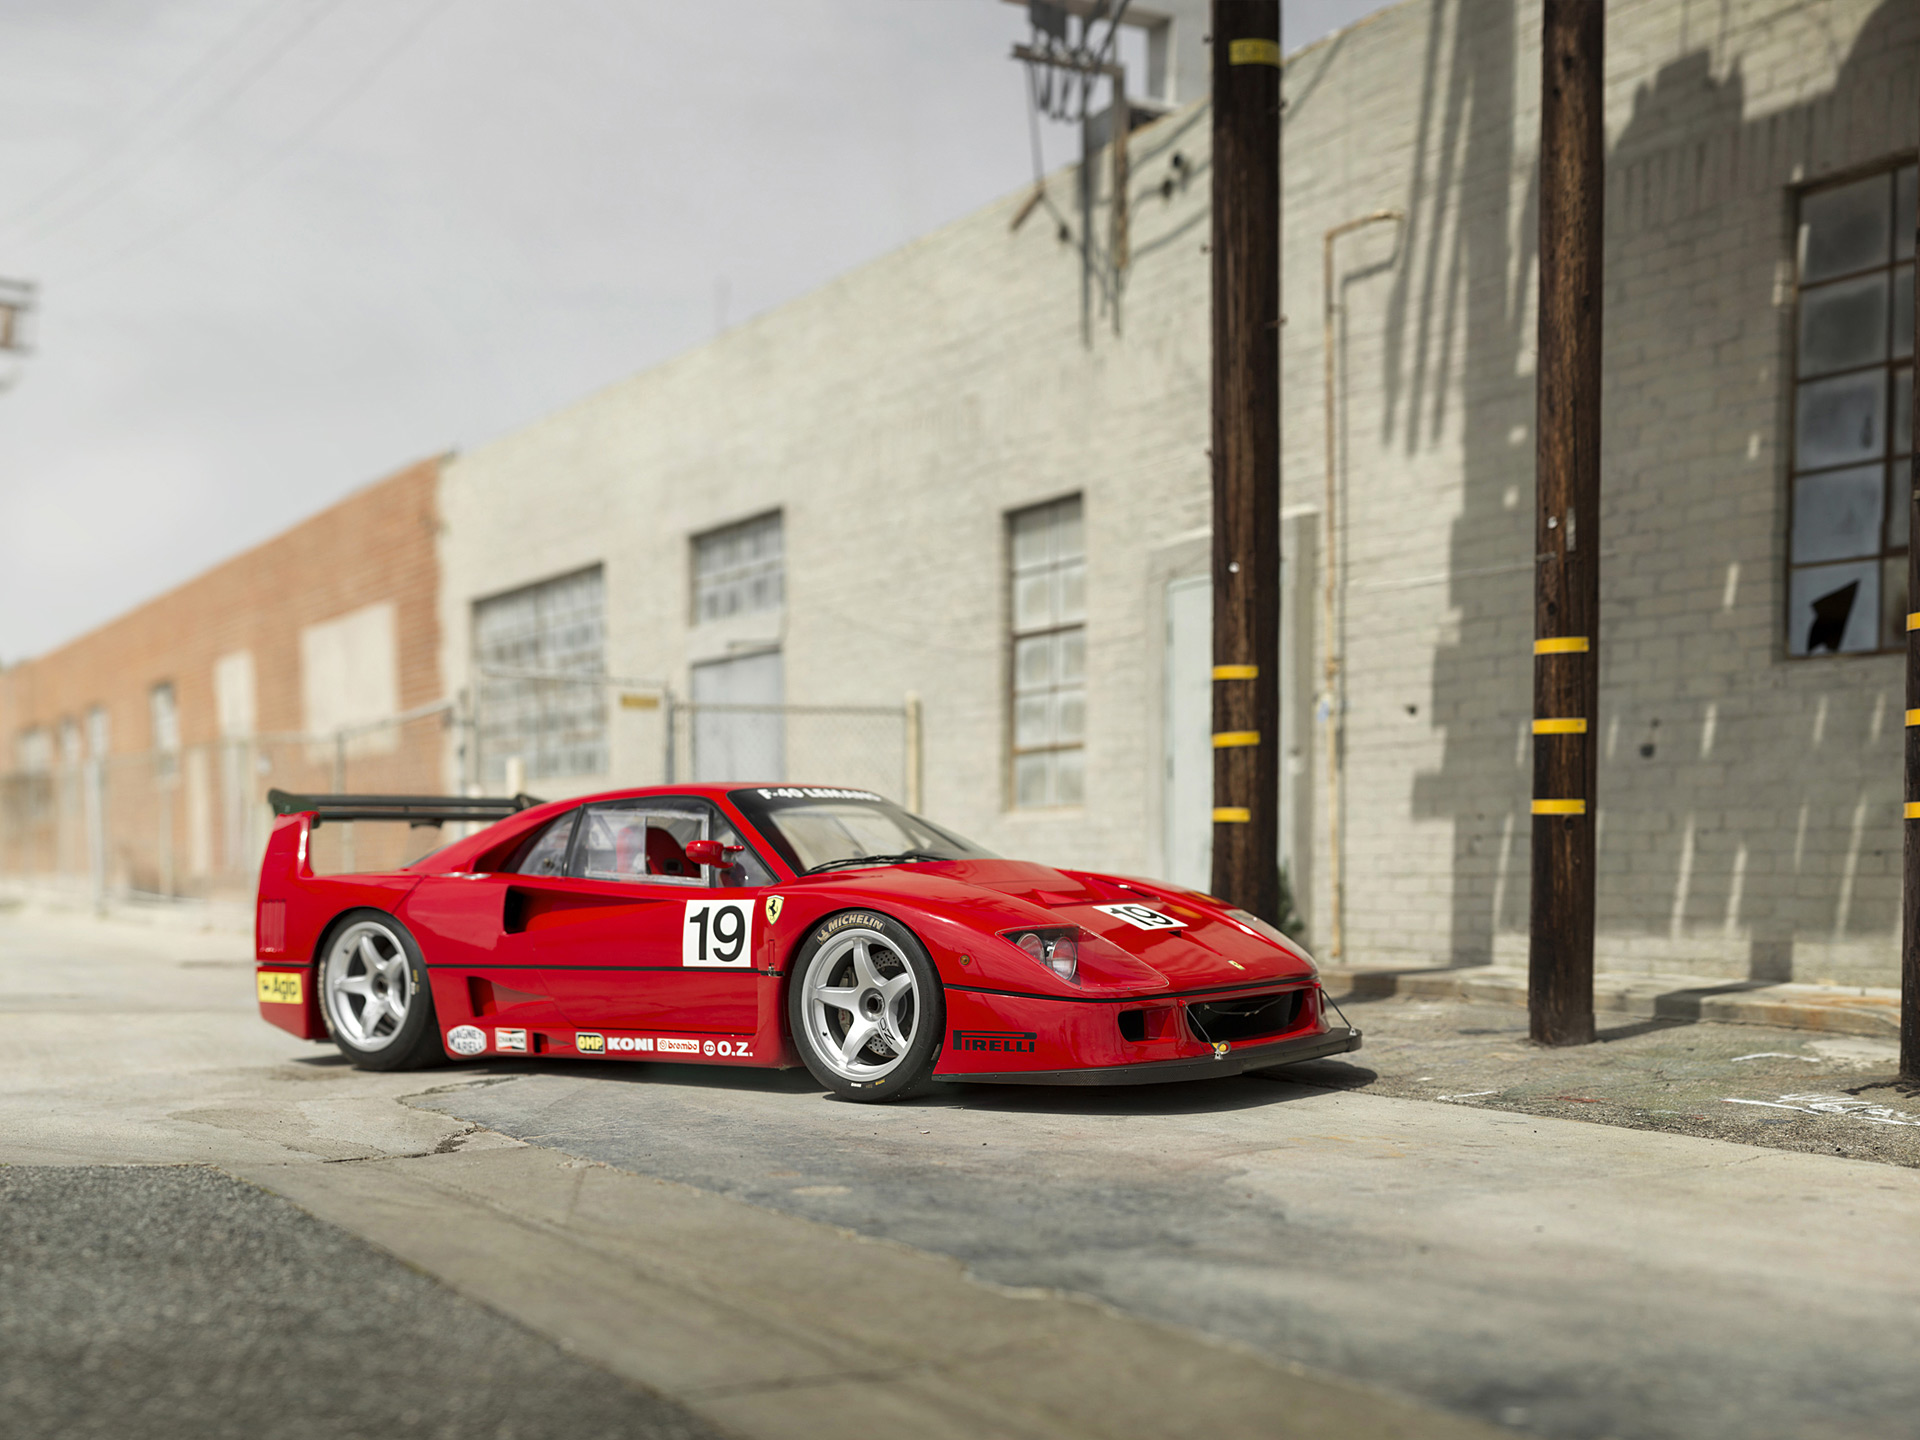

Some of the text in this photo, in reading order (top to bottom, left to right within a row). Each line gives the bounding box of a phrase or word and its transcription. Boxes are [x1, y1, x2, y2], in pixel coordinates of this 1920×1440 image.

[757, 788, 804, 800] F-40
[827, 914, 884, 932] MICHELIN
[1110, 906, 1174, 925] 19
[690, 905, 746, 962] 19
[577, 1036, 603, 1050] OMP
[607, 1037, 654, 1051] KONI
[667, 1042, 698, 1051] brembo
[717, 1041, 753, 1057] O.Z.
[953, 1030, 1037, 1053] PIRELLI
